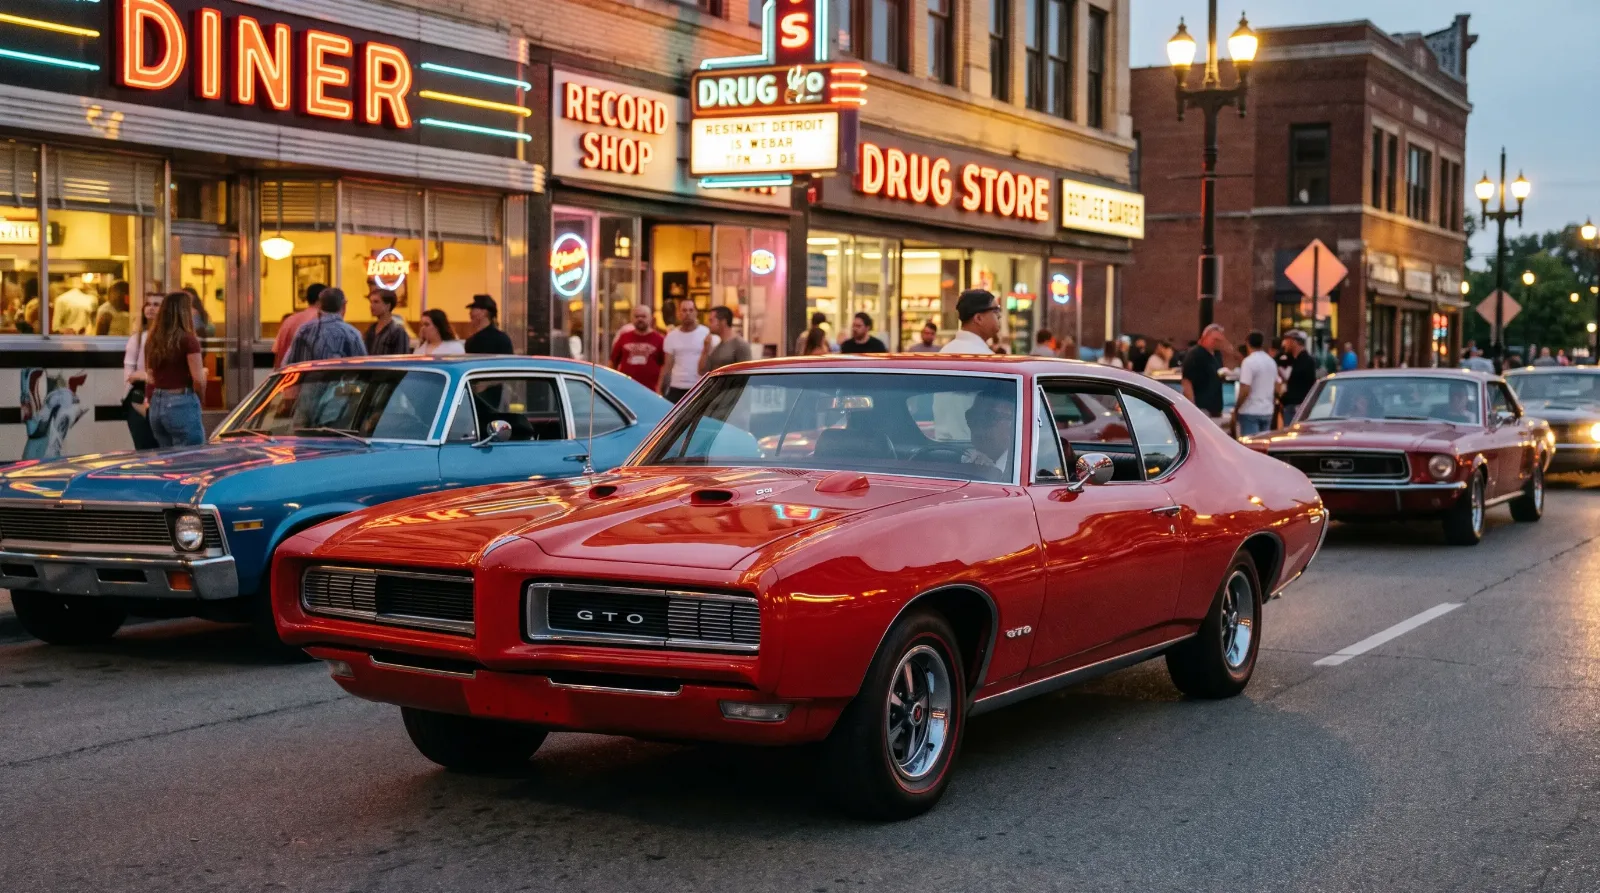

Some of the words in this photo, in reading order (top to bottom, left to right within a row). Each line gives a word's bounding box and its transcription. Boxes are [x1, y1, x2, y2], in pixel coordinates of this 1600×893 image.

[118, 0, 413, 129] DINER
[563, 82, 669, 135] RECORD
[698, 74, 779, 108] DRUG
[772, 119, 825, 133] DETROIT
[580, 131, 654, 175] SHOP
[860, 142, 952, 206] DRUG
[961, 163, 1051, 221] STORE
[576, 609, 645, 625] GTO
[1005, 625, 1032, 638] GTO
